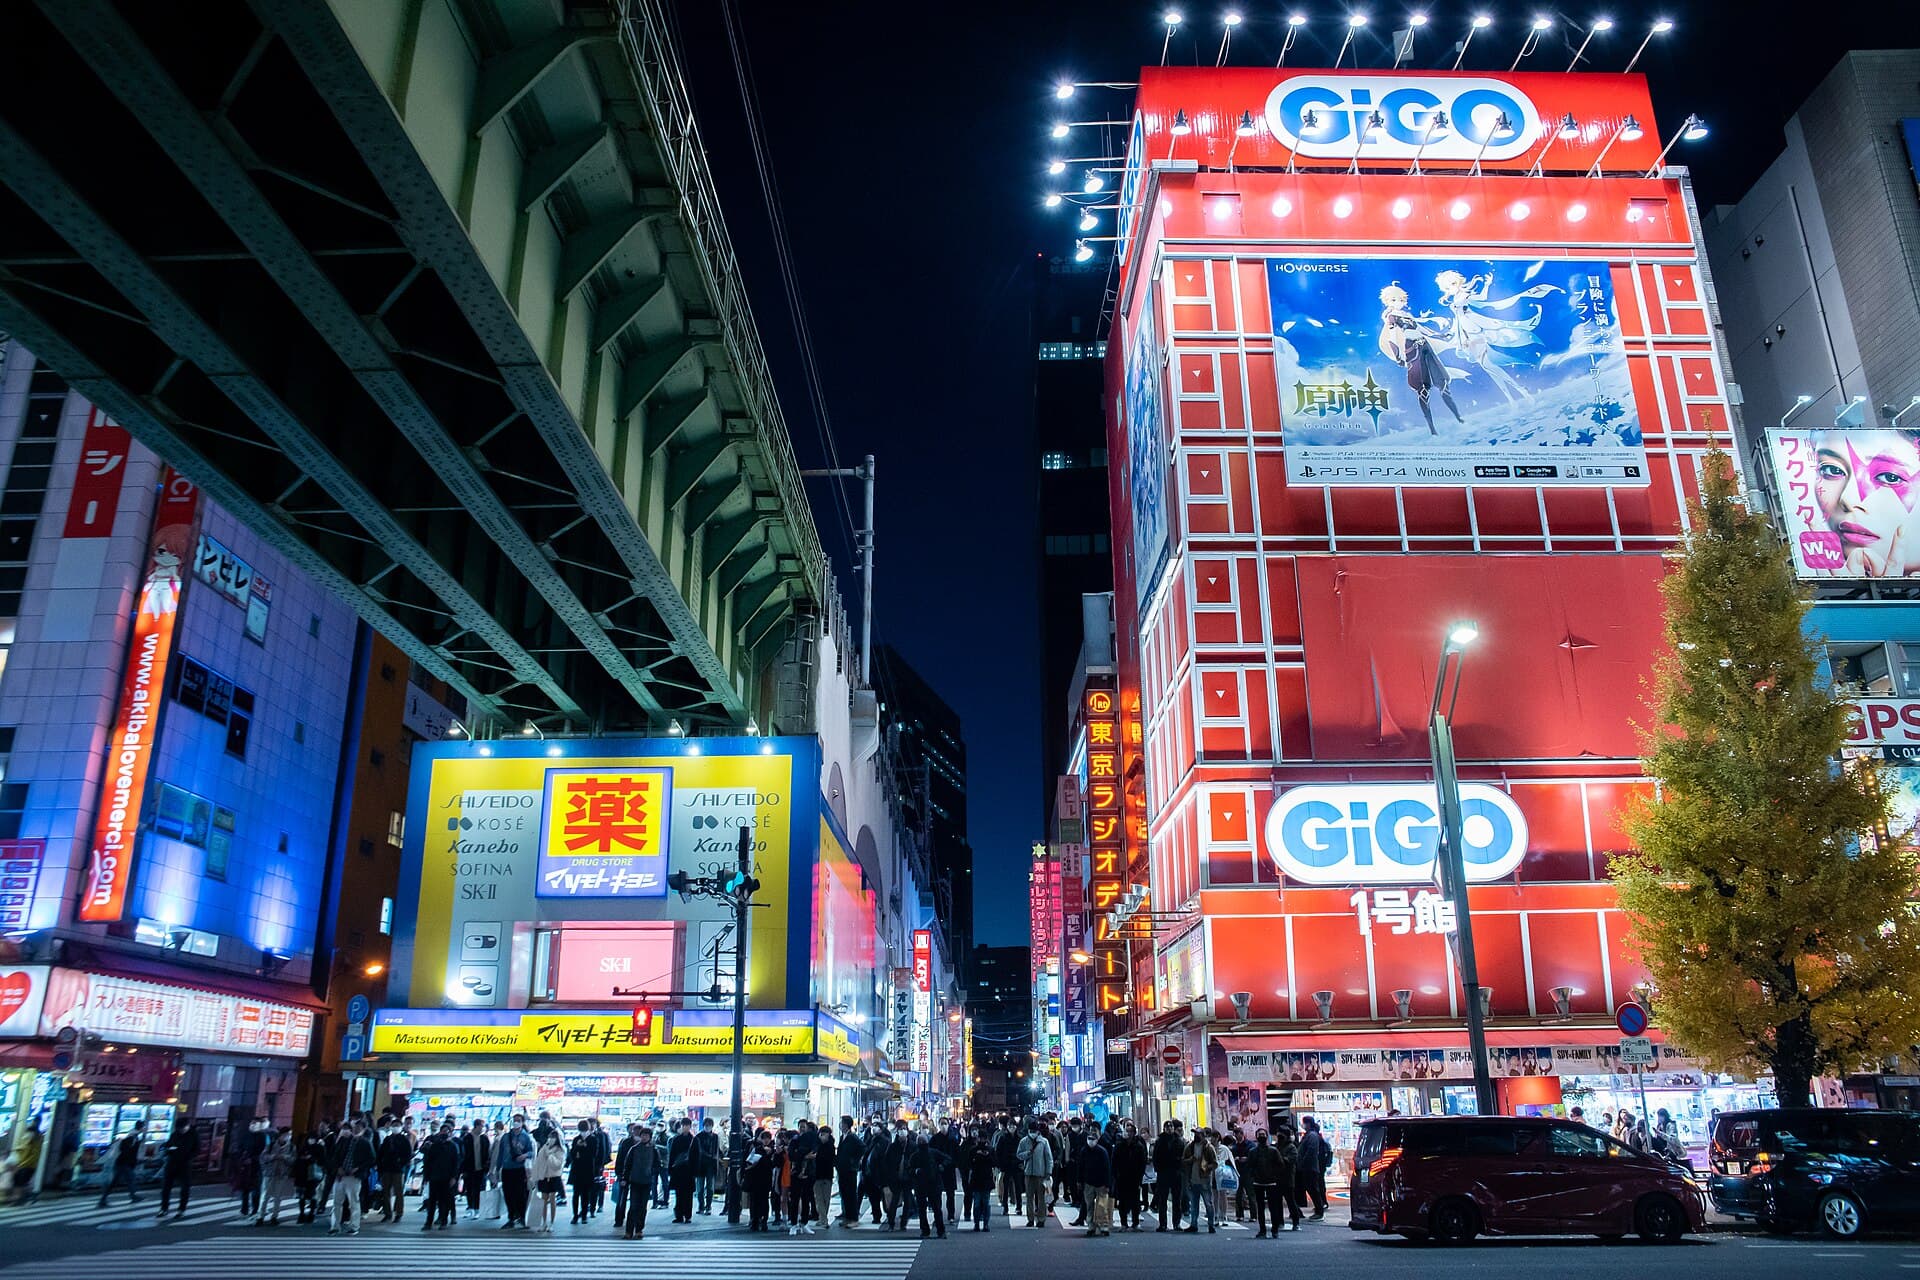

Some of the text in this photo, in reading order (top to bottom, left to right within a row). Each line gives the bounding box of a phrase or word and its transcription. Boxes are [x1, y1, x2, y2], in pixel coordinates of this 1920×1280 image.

[1280, 86, 1525, 146] GiGO
[1275, 263, 1349, 273] HOYOVERSE
[1293, 367, 1389, 437] 原神
[1320, 467, 1357, 476] PS5
[1369, 467, 1407, 476] PS4
[1415, 467, 1466, 477] Windows
[1526, 467, 1541, 475] Google
[1779, 437, 1814, 525] ワクワク
[440, 795, 534, 808] SHISEIDO
[682, 793, 780, 807] SHISEIDO
[564, 778, 649, 852] 薬
[724, 813, 771, 828] KOSÉ
[477, 816, 524, 830] KOSÉ
[1282, 799, 1513, 867] GiGO
[448, 839, 519, 853] Kanebo
[571, 858, 633, 866] DRUG STORE
[698, 861, 763, 875] SOFIA
[450, 863, 513, 876] SOFINA
[545, 868, 658, 894] マツモトキヨシ
[461, 884, 497, 900] SK-II
[1350, 890, 1456, 936] 1号館
[599, 957, 631, 973] SK-II
[395, 1033, 518, 1045] Matsumoto KiYoshi
[538, 1024, 633, 1048] マツモトキヨ
[744, 1035, 793, 1046] KiYoshi
